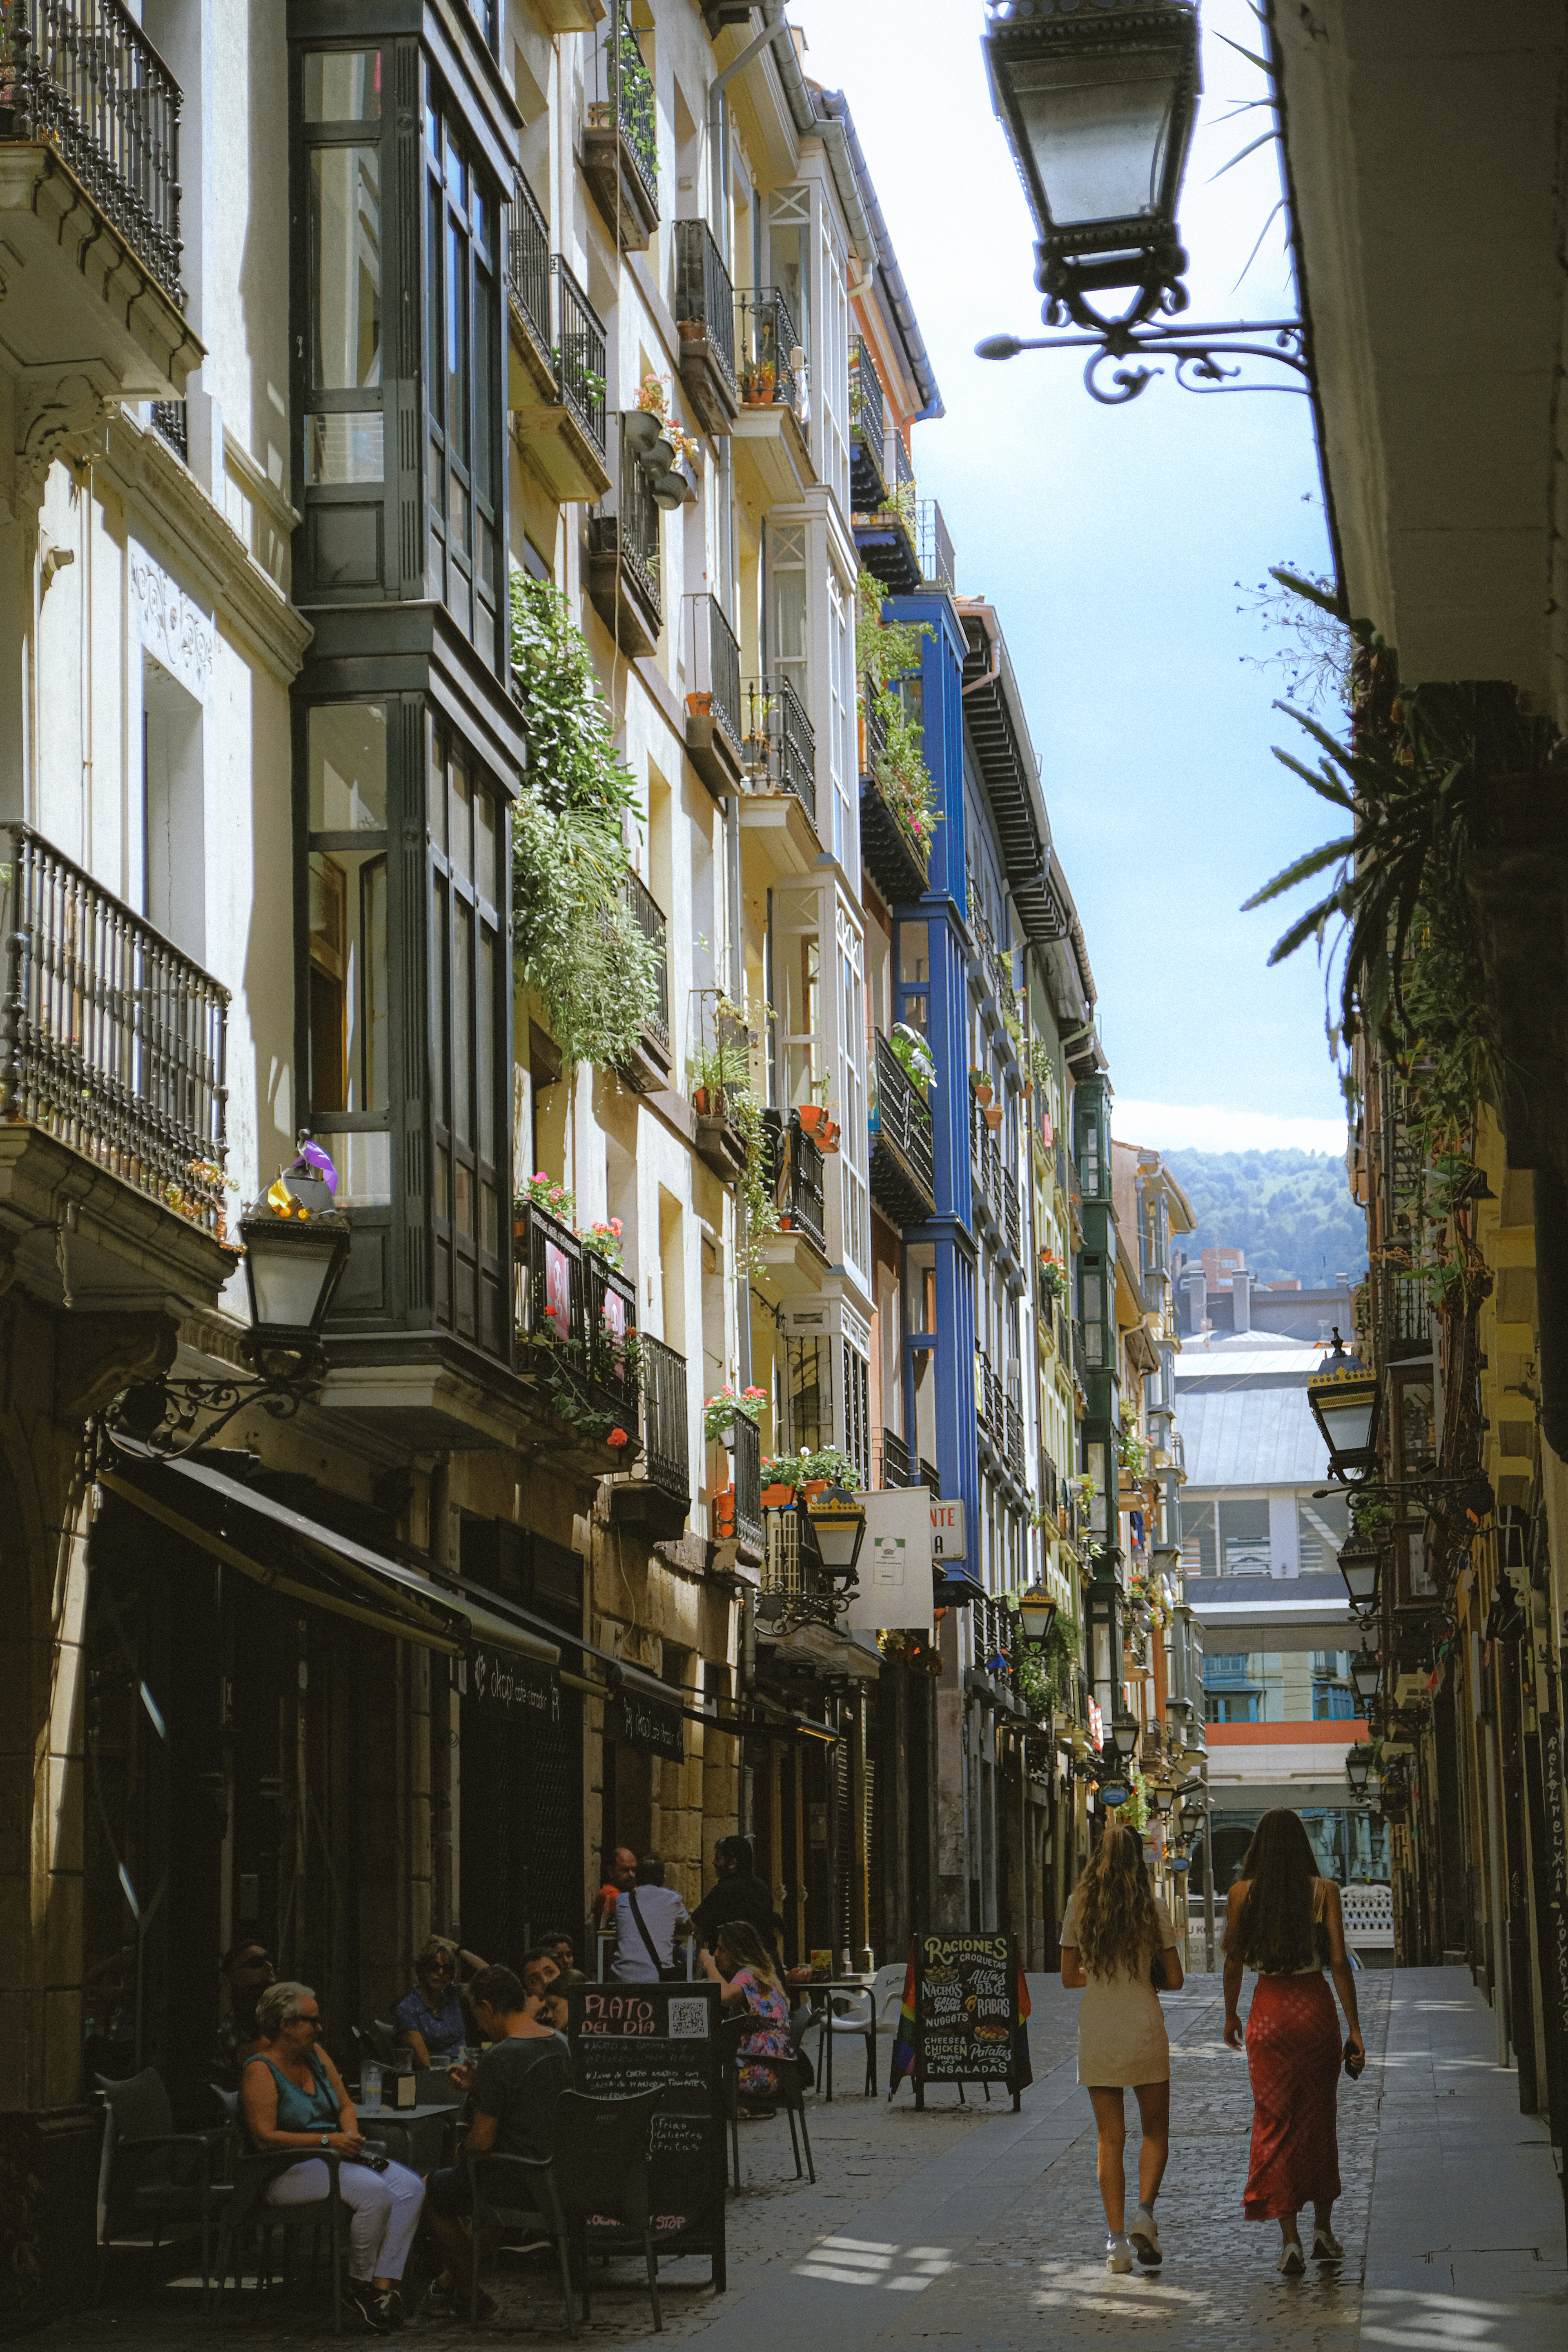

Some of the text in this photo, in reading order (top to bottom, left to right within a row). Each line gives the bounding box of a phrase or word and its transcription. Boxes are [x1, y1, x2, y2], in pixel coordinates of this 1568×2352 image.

[960, 1953, 1007, 1969] CROQUETAS
[922, 1981, 963, 2000] NACHOS
[585, 1994, 653, 2020] PLATO
[977, 1998, 1010, 2018] RABAS
[581, 2020, 612, 2034] DEL
[925, 2045, 967, 2056] CHICKEN
[927, 2062, 1008, 2074] ENSALADAS
